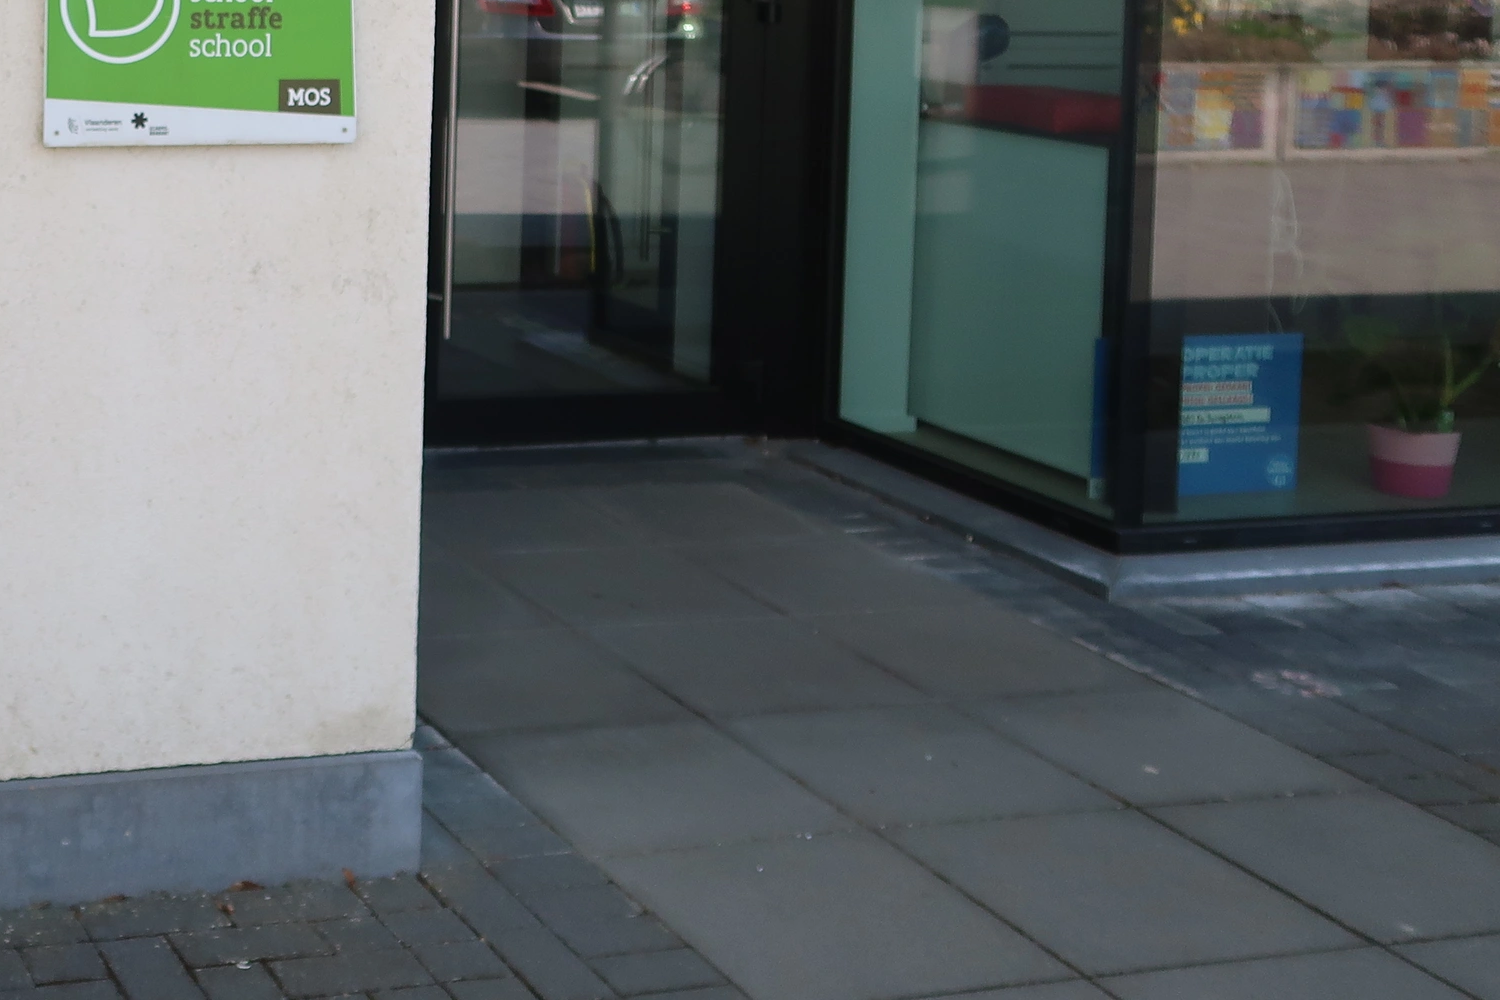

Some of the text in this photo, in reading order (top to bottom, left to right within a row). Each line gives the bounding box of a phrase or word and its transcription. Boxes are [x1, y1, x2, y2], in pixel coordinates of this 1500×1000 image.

[190, 6, 283, 30] straffe
[189, 33, 272, 58] school
[287, 88, 331, 107] MOS
